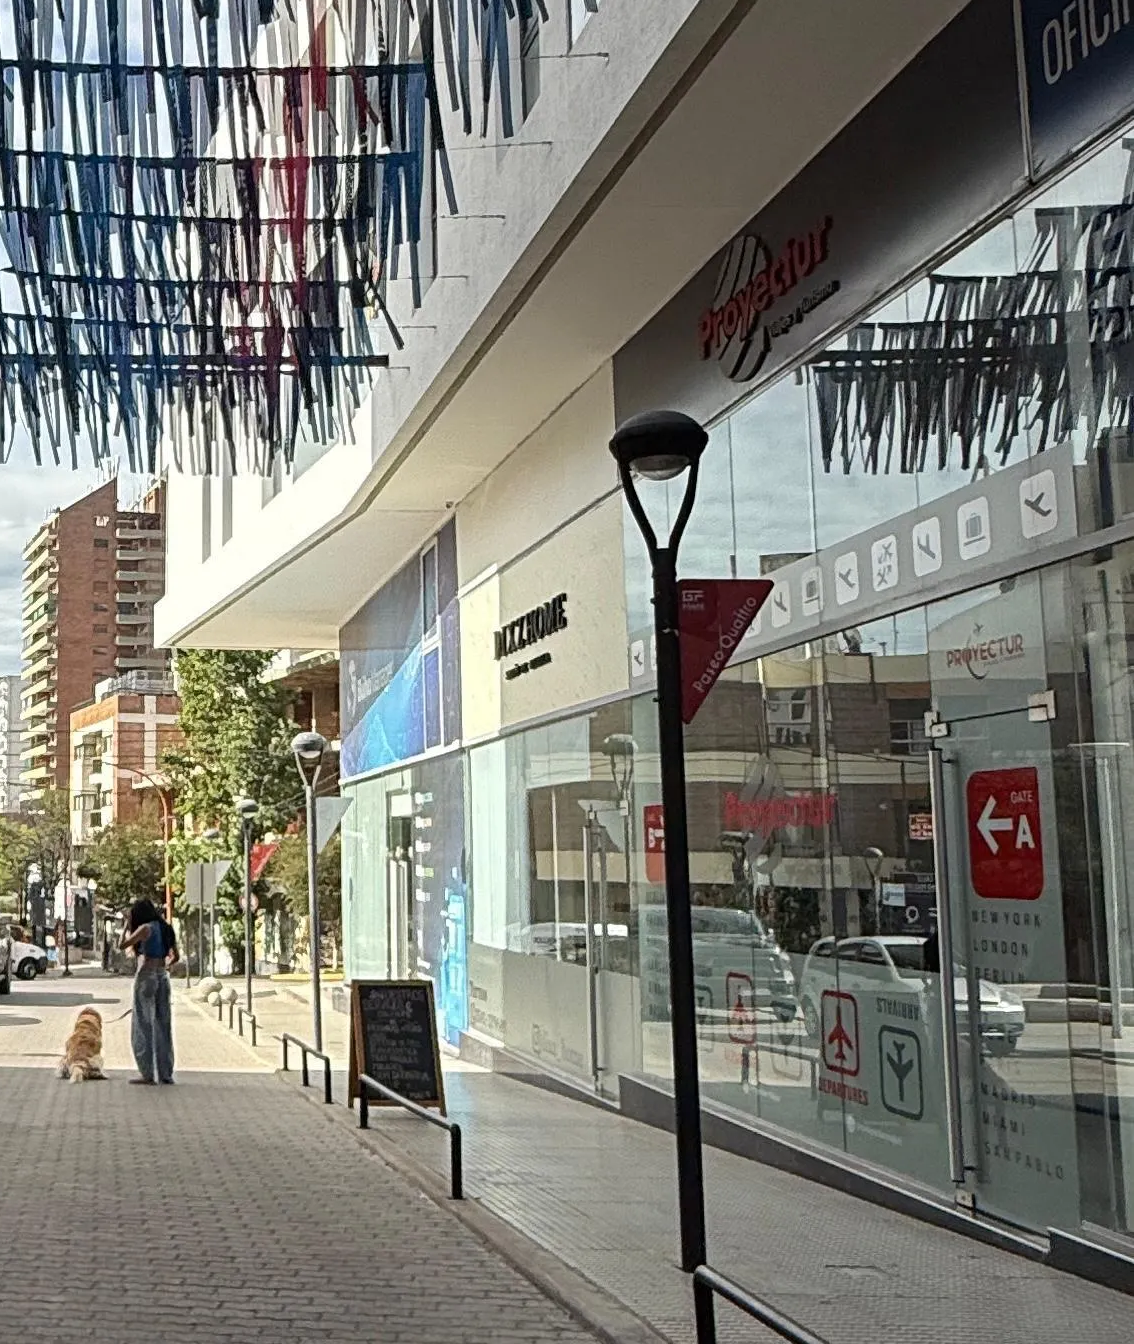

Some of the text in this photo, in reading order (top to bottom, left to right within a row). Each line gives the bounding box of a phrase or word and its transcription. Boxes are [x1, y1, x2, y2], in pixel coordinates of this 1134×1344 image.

[692, 650, 724, 693] Paseo
[721, 597, 757, 649] Quattro
[946, 633, 1024, 668] PROYECTUR
[1011, 791, 1033, 804] GATE
[1015, 814, 1036, 849] A
[971, 909, 1041, 928] NEW YORK
[973, 939, 1028, 958] LONDON
